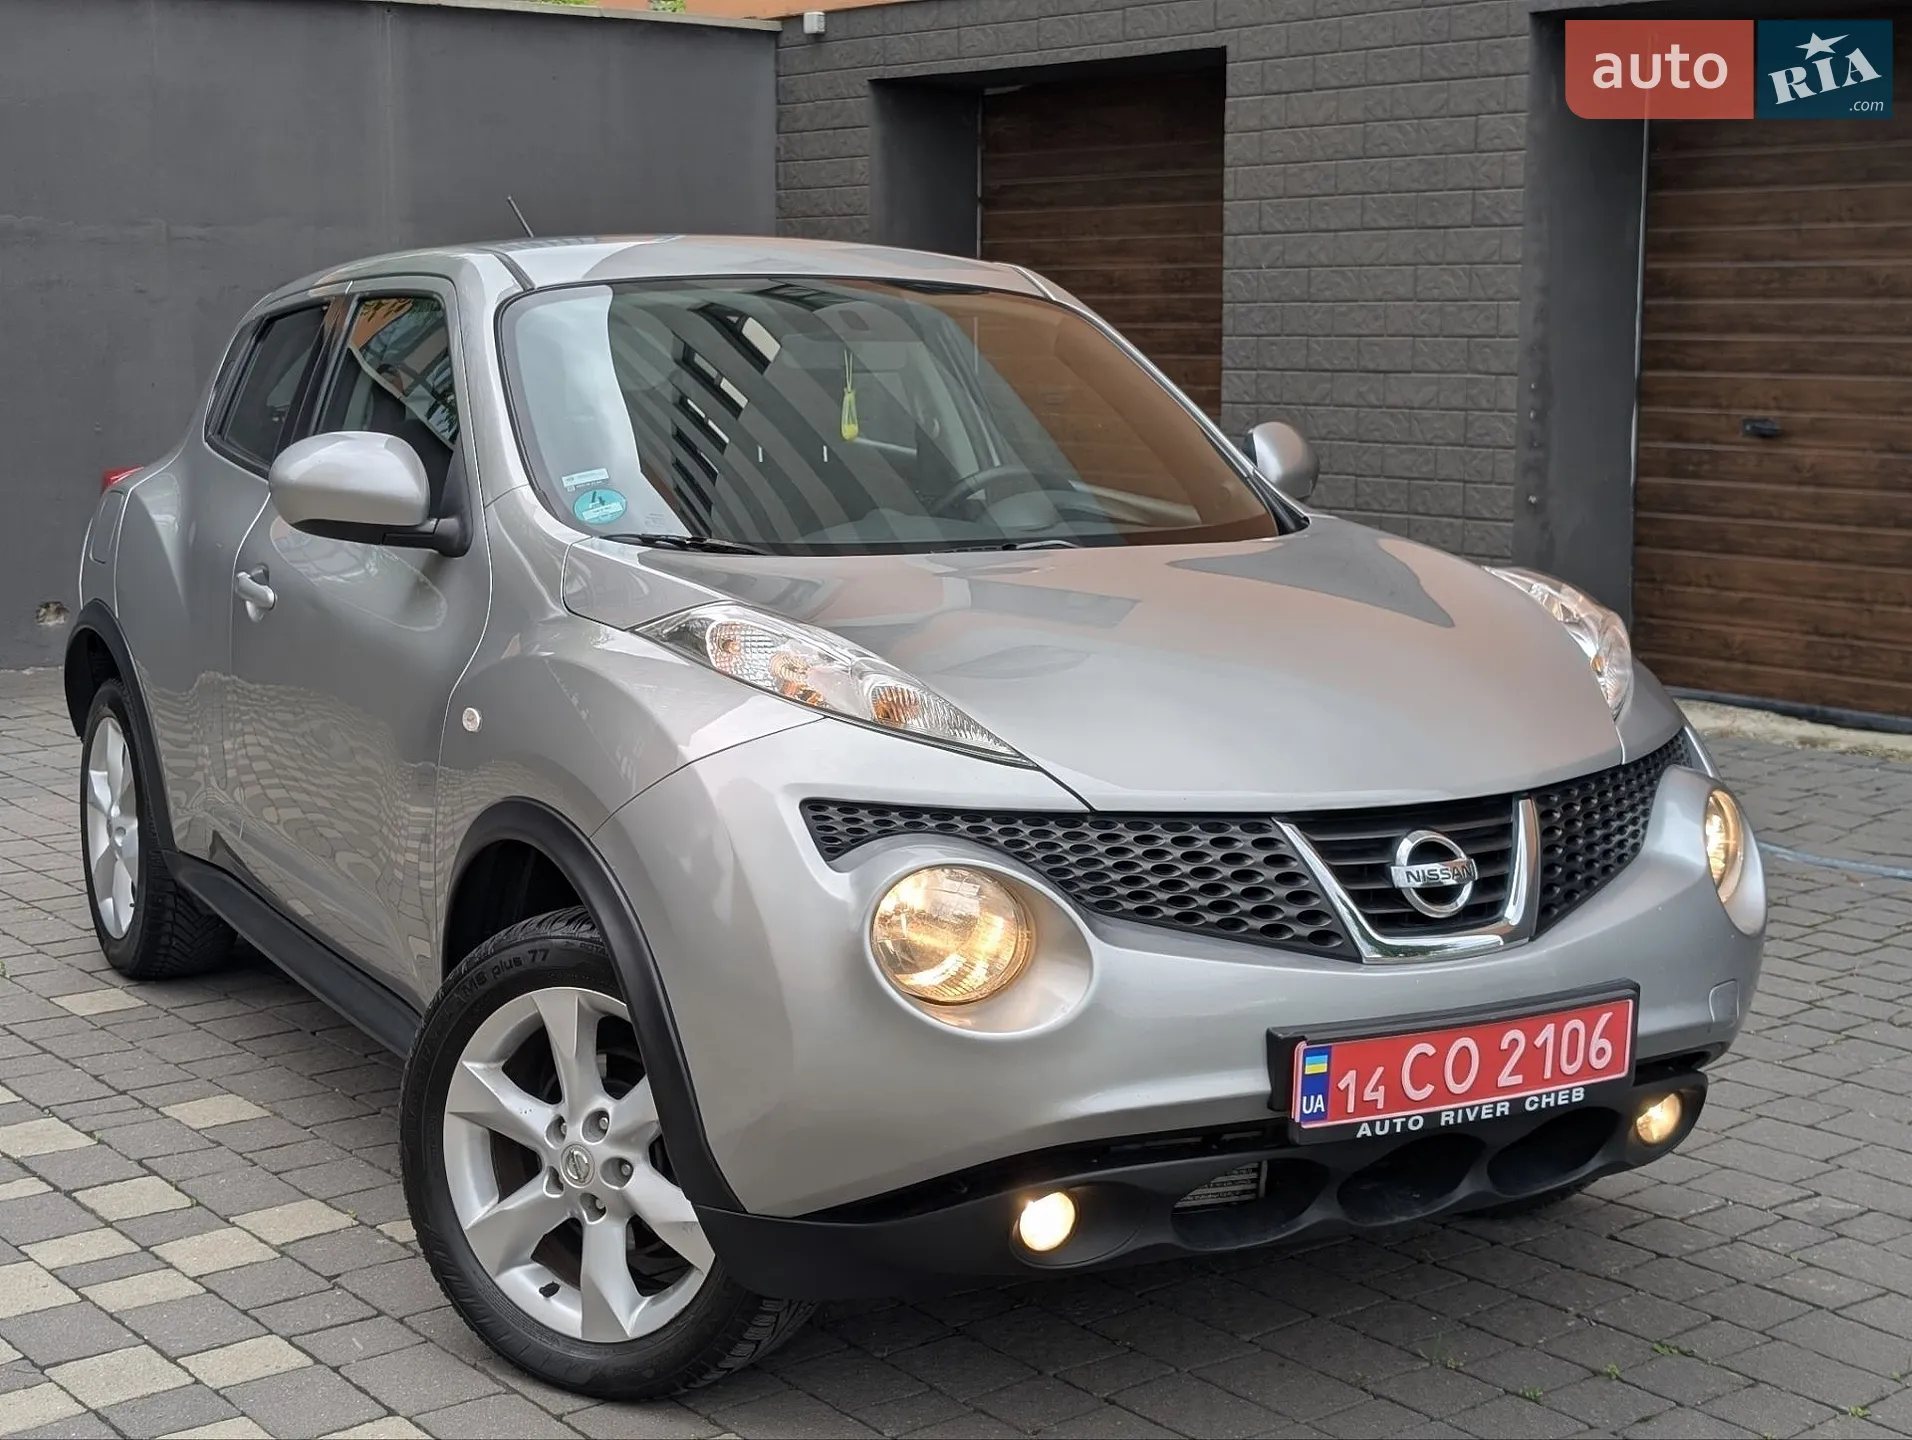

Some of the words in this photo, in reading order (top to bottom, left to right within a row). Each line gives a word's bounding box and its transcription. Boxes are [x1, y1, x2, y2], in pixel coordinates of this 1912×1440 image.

[1405, 864, 1475, 884] NISSAN
[492, 956, 522, 980] plus
[527, 948, 548, 963] 77
[1336, 1066, 1386, 1113] 14
[1401, 1037, 1480, 1101] CO
[1497, 1012, 1613, 1088] 2106
[1301, 1095, 1326, 1115] UA
[1355, 1115, 1425, 1139] AUTO
[1441, 1102, 1511, 1127] RIVER
[1525, 1088, 1585, 1112] CHEB
